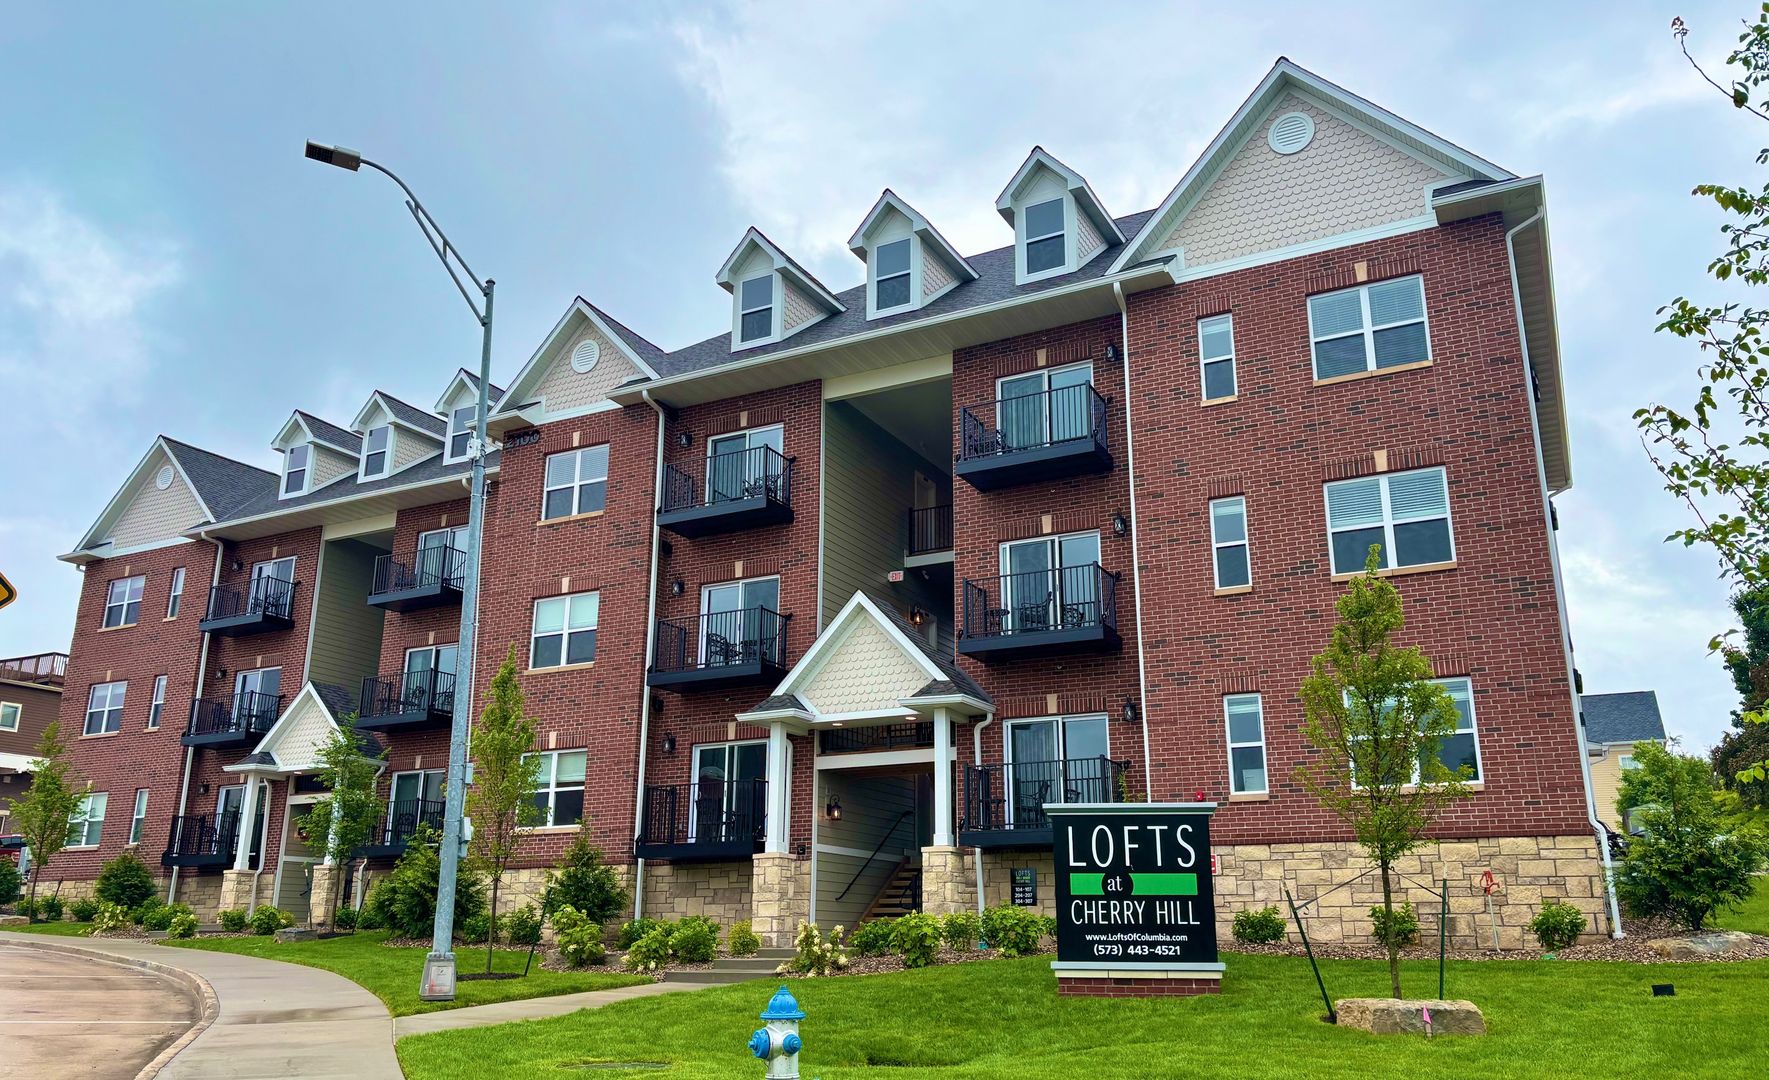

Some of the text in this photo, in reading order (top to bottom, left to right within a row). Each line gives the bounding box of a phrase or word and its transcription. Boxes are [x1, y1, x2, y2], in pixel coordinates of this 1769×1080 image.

[1068, 824, 1196, 868] LOFTS
[1107, 876, 1123, 891] at
[1071, 899, 1200, 925] CHERRY HILL
[1085, 933, 1188, 942] www.LoftsOfColumbia.com
[1093, 943, 1181, 957] (573) 443-4521
